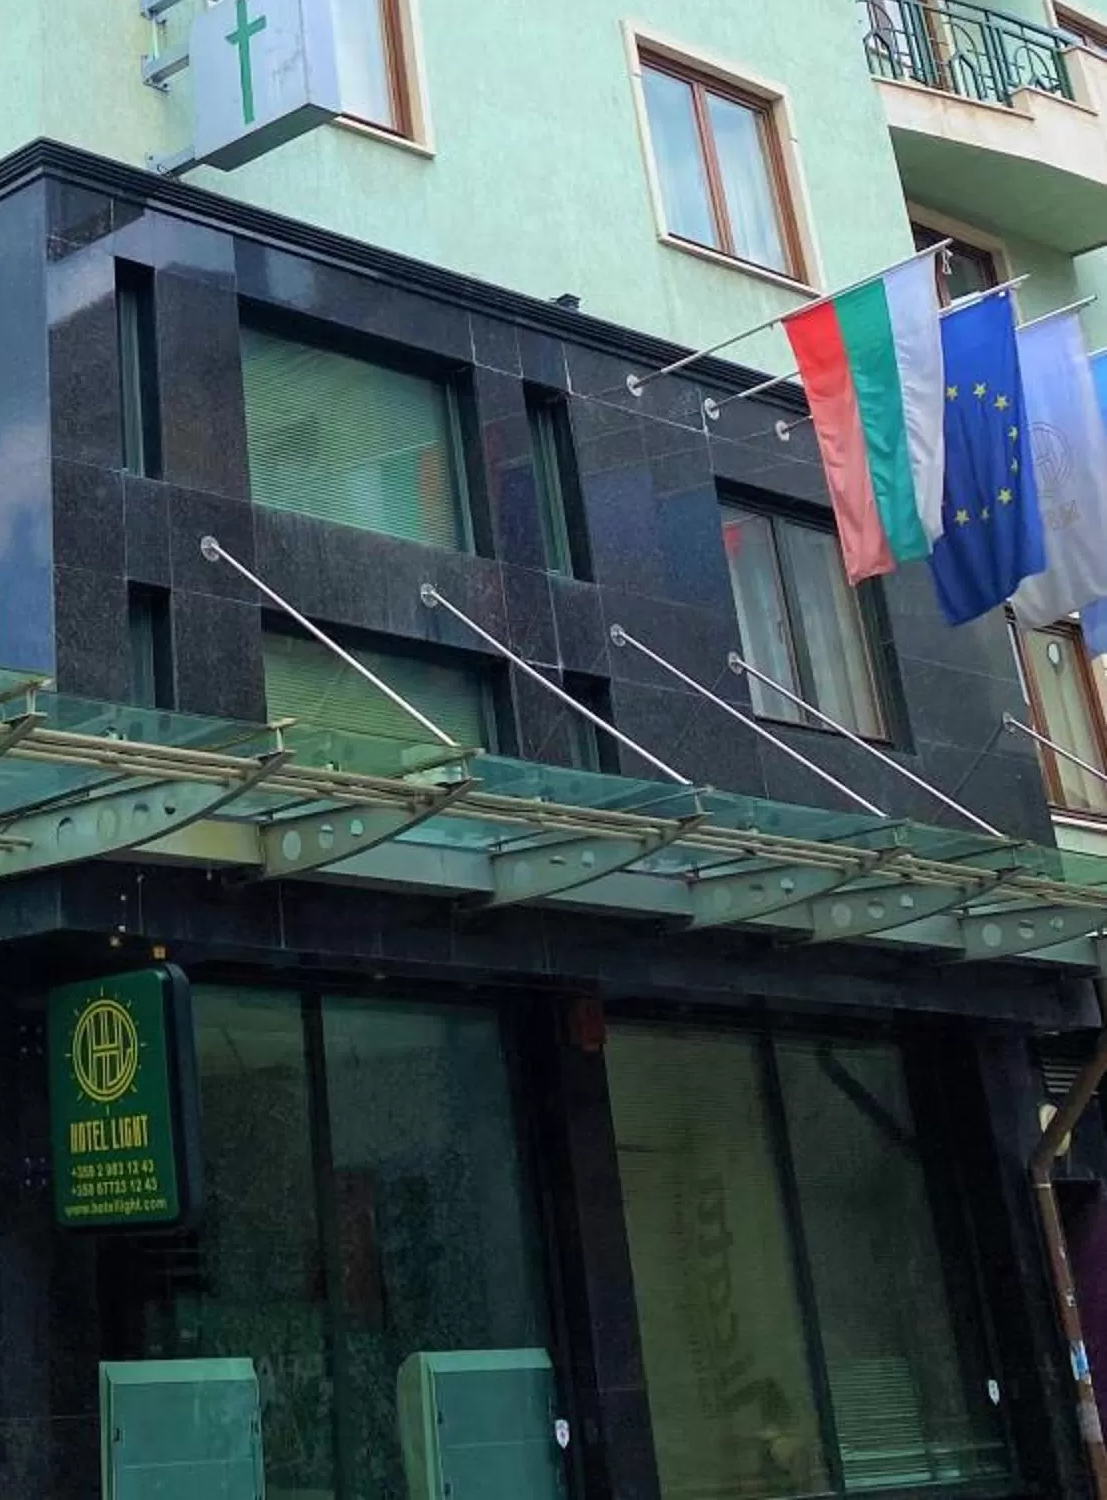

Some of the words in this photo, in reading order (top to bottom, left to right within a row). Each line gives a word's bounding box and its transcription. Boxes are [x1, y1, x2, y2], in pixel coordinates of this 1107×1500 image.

[70, 1119, 109, 1154] HOTEL
[111, 1114, 148, 1149] LIGHT
[64, 1197, 167, 1217] www.hotellight.com
